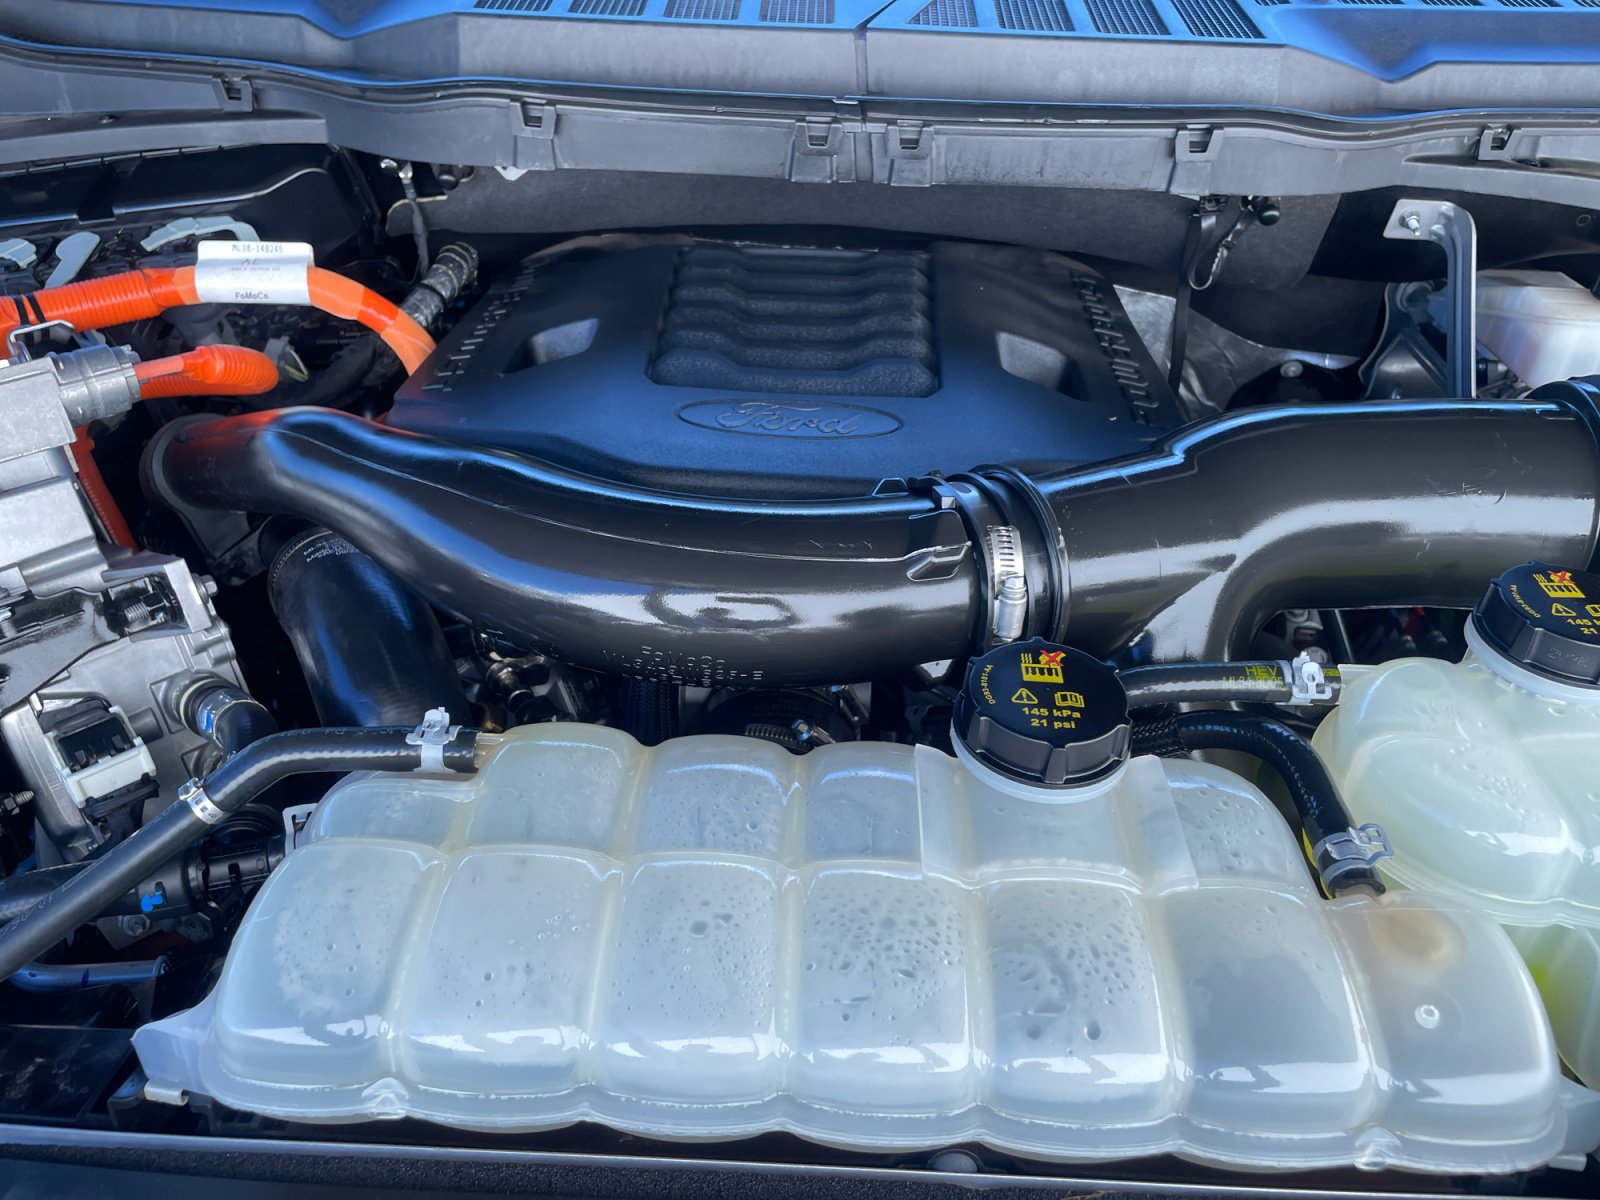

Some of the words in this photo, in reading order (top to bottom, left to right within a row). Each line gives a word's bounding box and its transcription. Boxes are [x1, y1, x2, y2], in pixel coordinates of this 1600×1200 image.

[235, 291, 269, 300] FoMoCo
[715, 401, 864, 435] Ford
[1566, 618, 1592, 626] 145
[1244, 665, 1278, 676] HEV
[1022, 707, 1049, 717] 145
[1053, 709, 1082, 719] kPa
[1030, 718, 1048, 727] 21
[1053, 721, 1076, 729] psi
